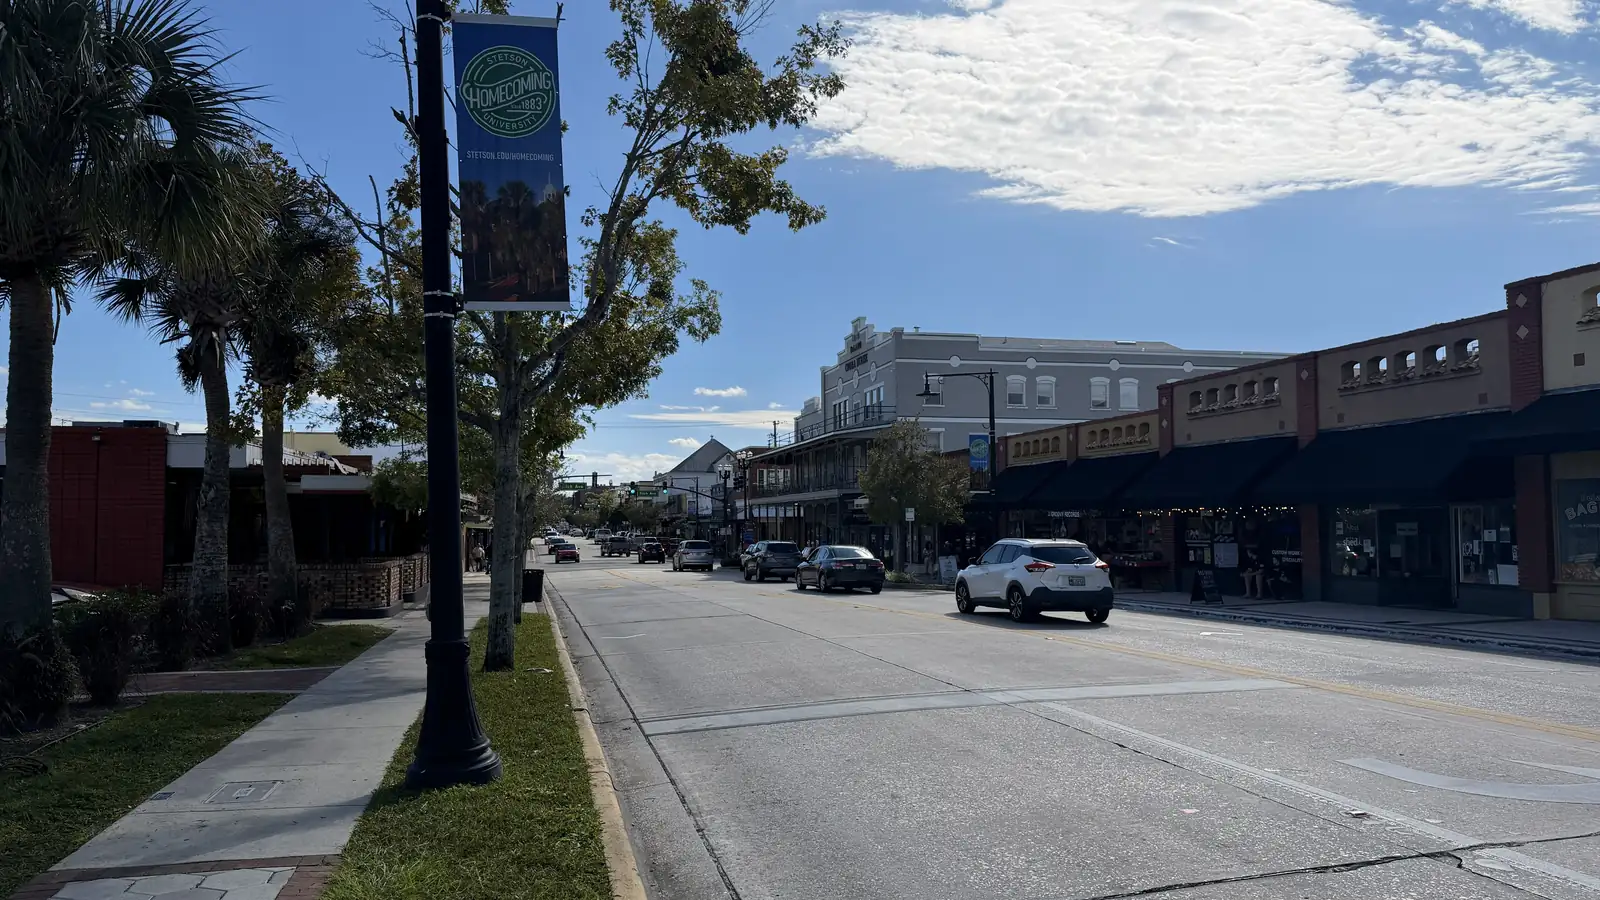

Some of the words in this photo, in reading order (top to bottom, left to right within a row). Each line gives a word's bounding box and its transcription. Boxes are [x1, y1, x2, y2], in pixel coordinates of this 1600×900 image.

[486, 53, 529, 67] STETSON
[462, 71, 552, 109] HOMECOMING
[521, 97, 542, 111] 1883
[483, 112, 538, 130] UNIVERSITY
[466, 150, 554, 162] STETSON.EDU/HOMECOMING
[1564, 501, 1600, 521] BAG
